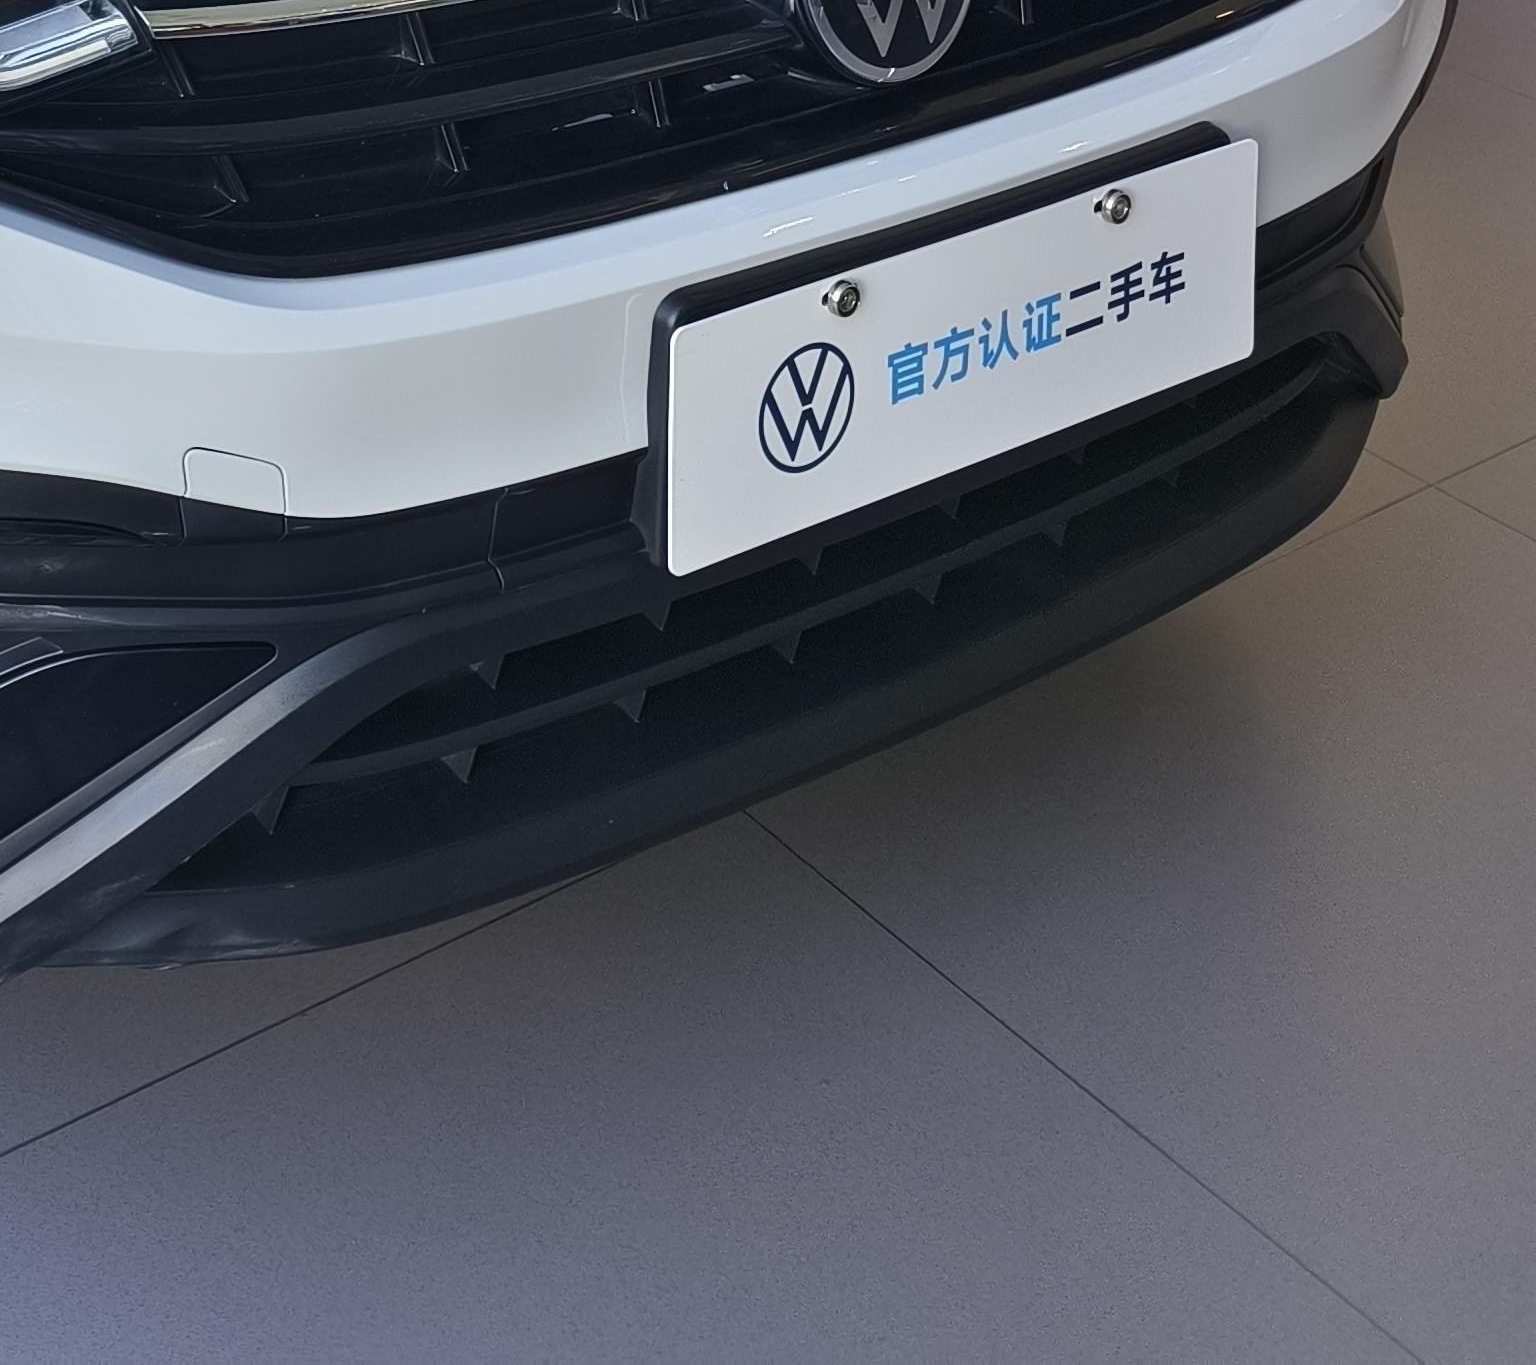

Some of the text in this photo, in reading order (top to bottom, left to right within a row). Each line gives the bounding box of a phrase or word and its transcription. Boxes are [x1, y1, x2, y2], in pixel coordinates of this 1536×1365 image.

[886, 250, 1186, 406] 官方认证二手车
